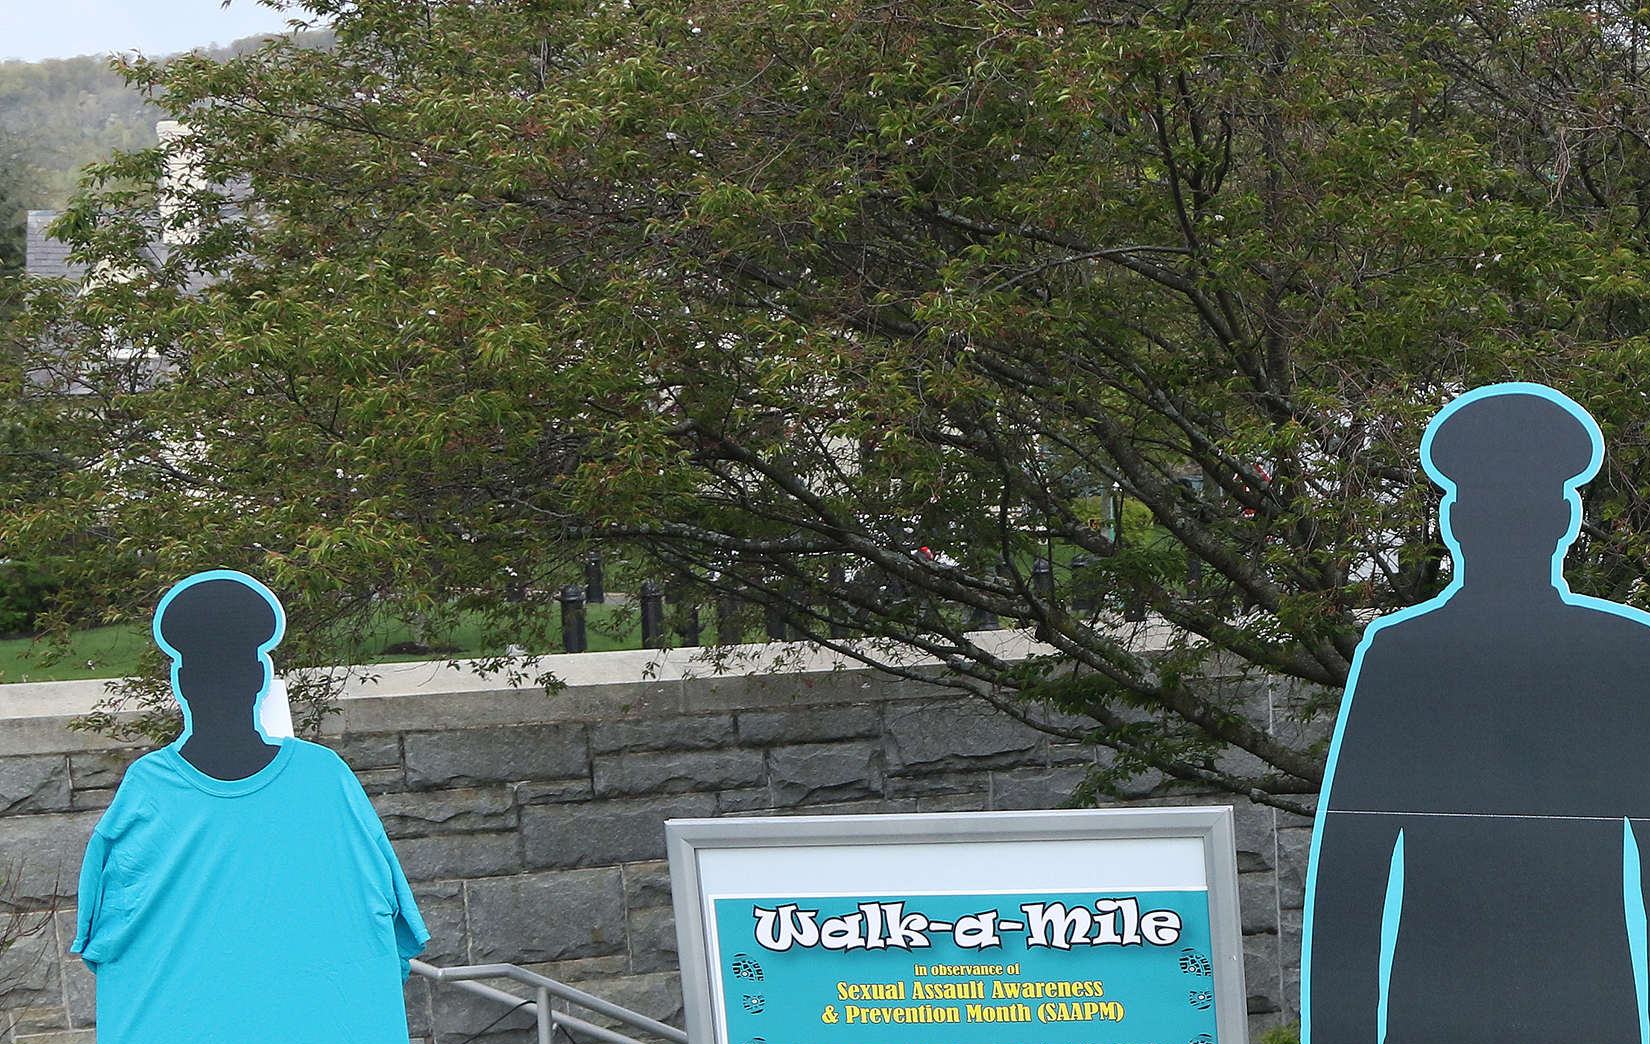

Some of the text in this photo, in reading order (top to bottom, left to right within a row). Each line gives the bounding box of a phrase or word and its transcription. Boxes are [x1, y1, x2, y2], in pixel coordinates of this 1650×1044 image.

[753, 897, 1183, 953] Walk-a-Mile
[913, 962, 1020, 977] in observance of
[836, 980, 1105, 1002] Sexual Assault Awareness
[843, 1004, 961, 1024] Prevention
[964, 1003, 1032, 1023] Month
[1036, 1002, 1125, 1023] (SAAPM)
